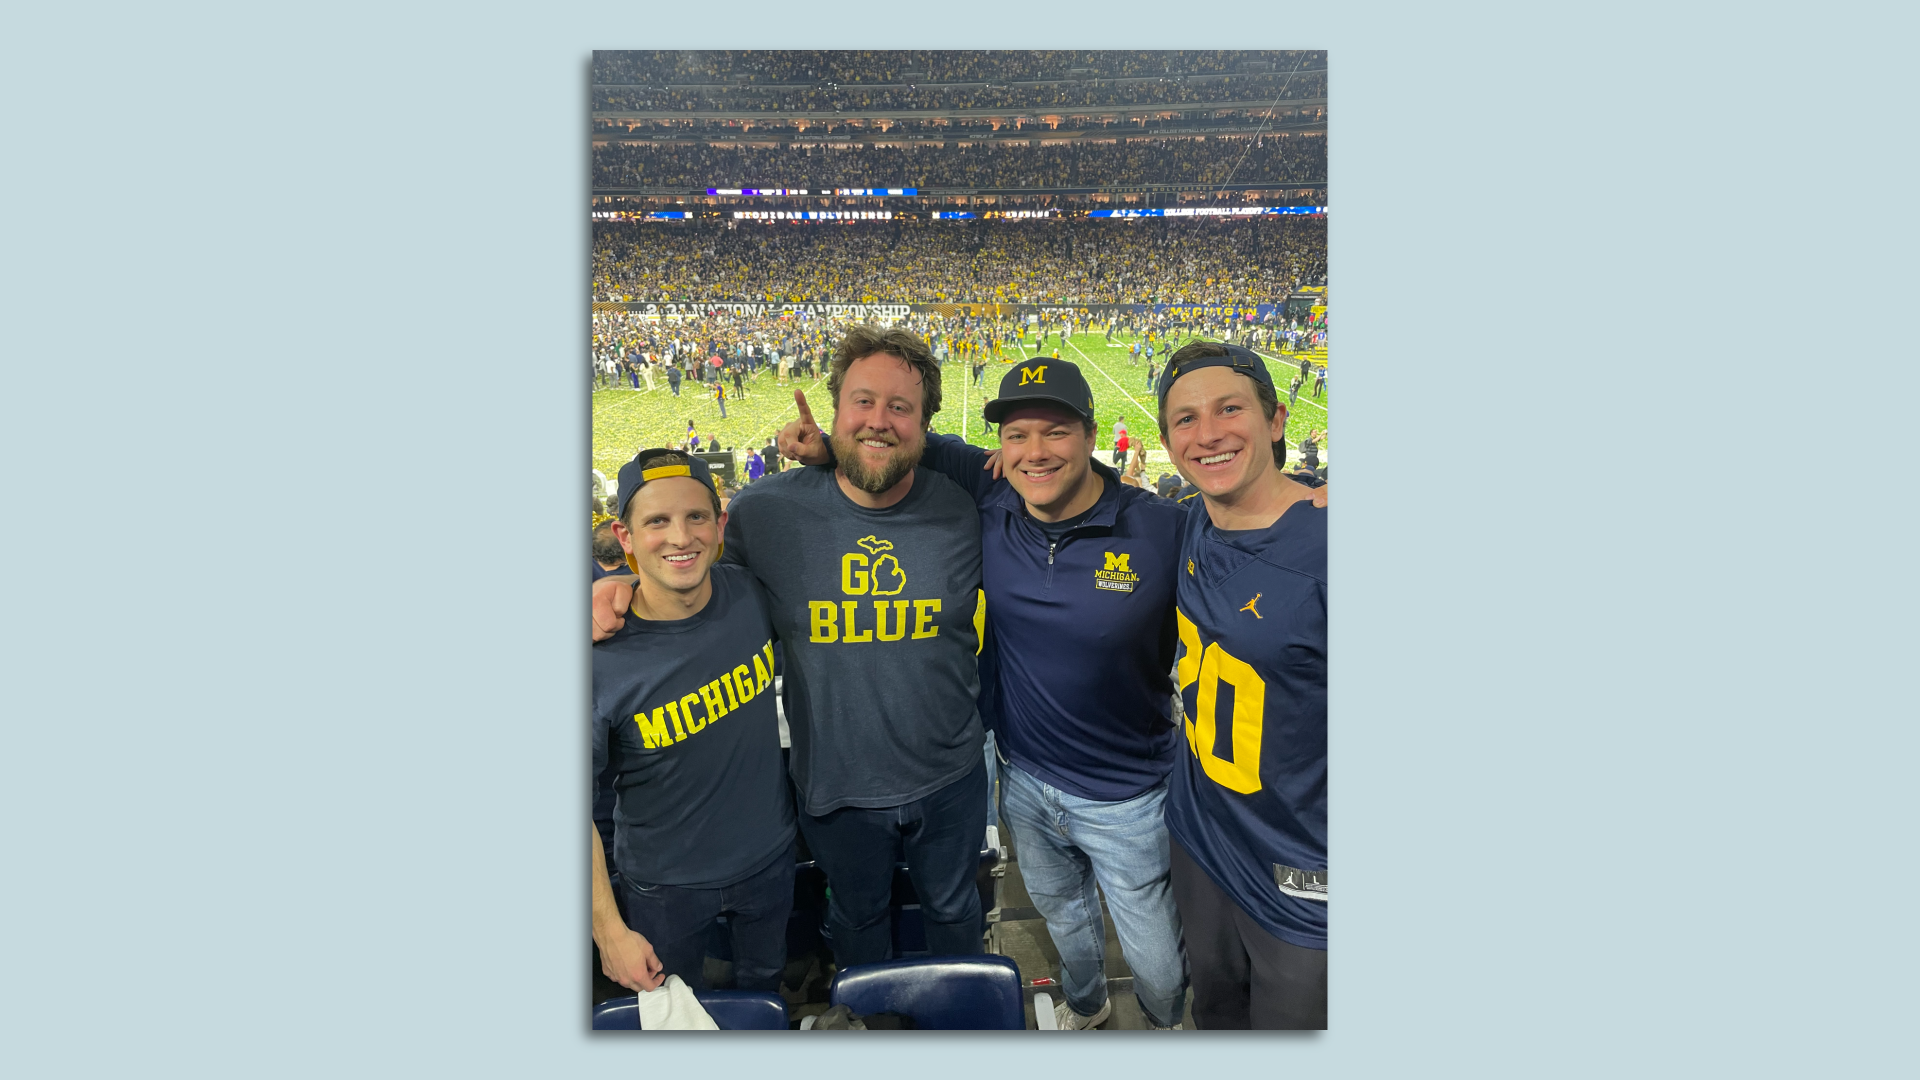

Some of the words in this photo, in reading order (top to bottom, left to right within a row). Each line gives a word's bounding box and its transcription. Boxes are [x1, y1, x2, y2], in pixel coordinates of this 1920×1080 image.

[1019, 365, 1048, 387] M
[1104, 551, 1130, 572] M
[1094, 569, 1138, 581] MICHIGAN
[808, 599, 942, 643] BLUE
